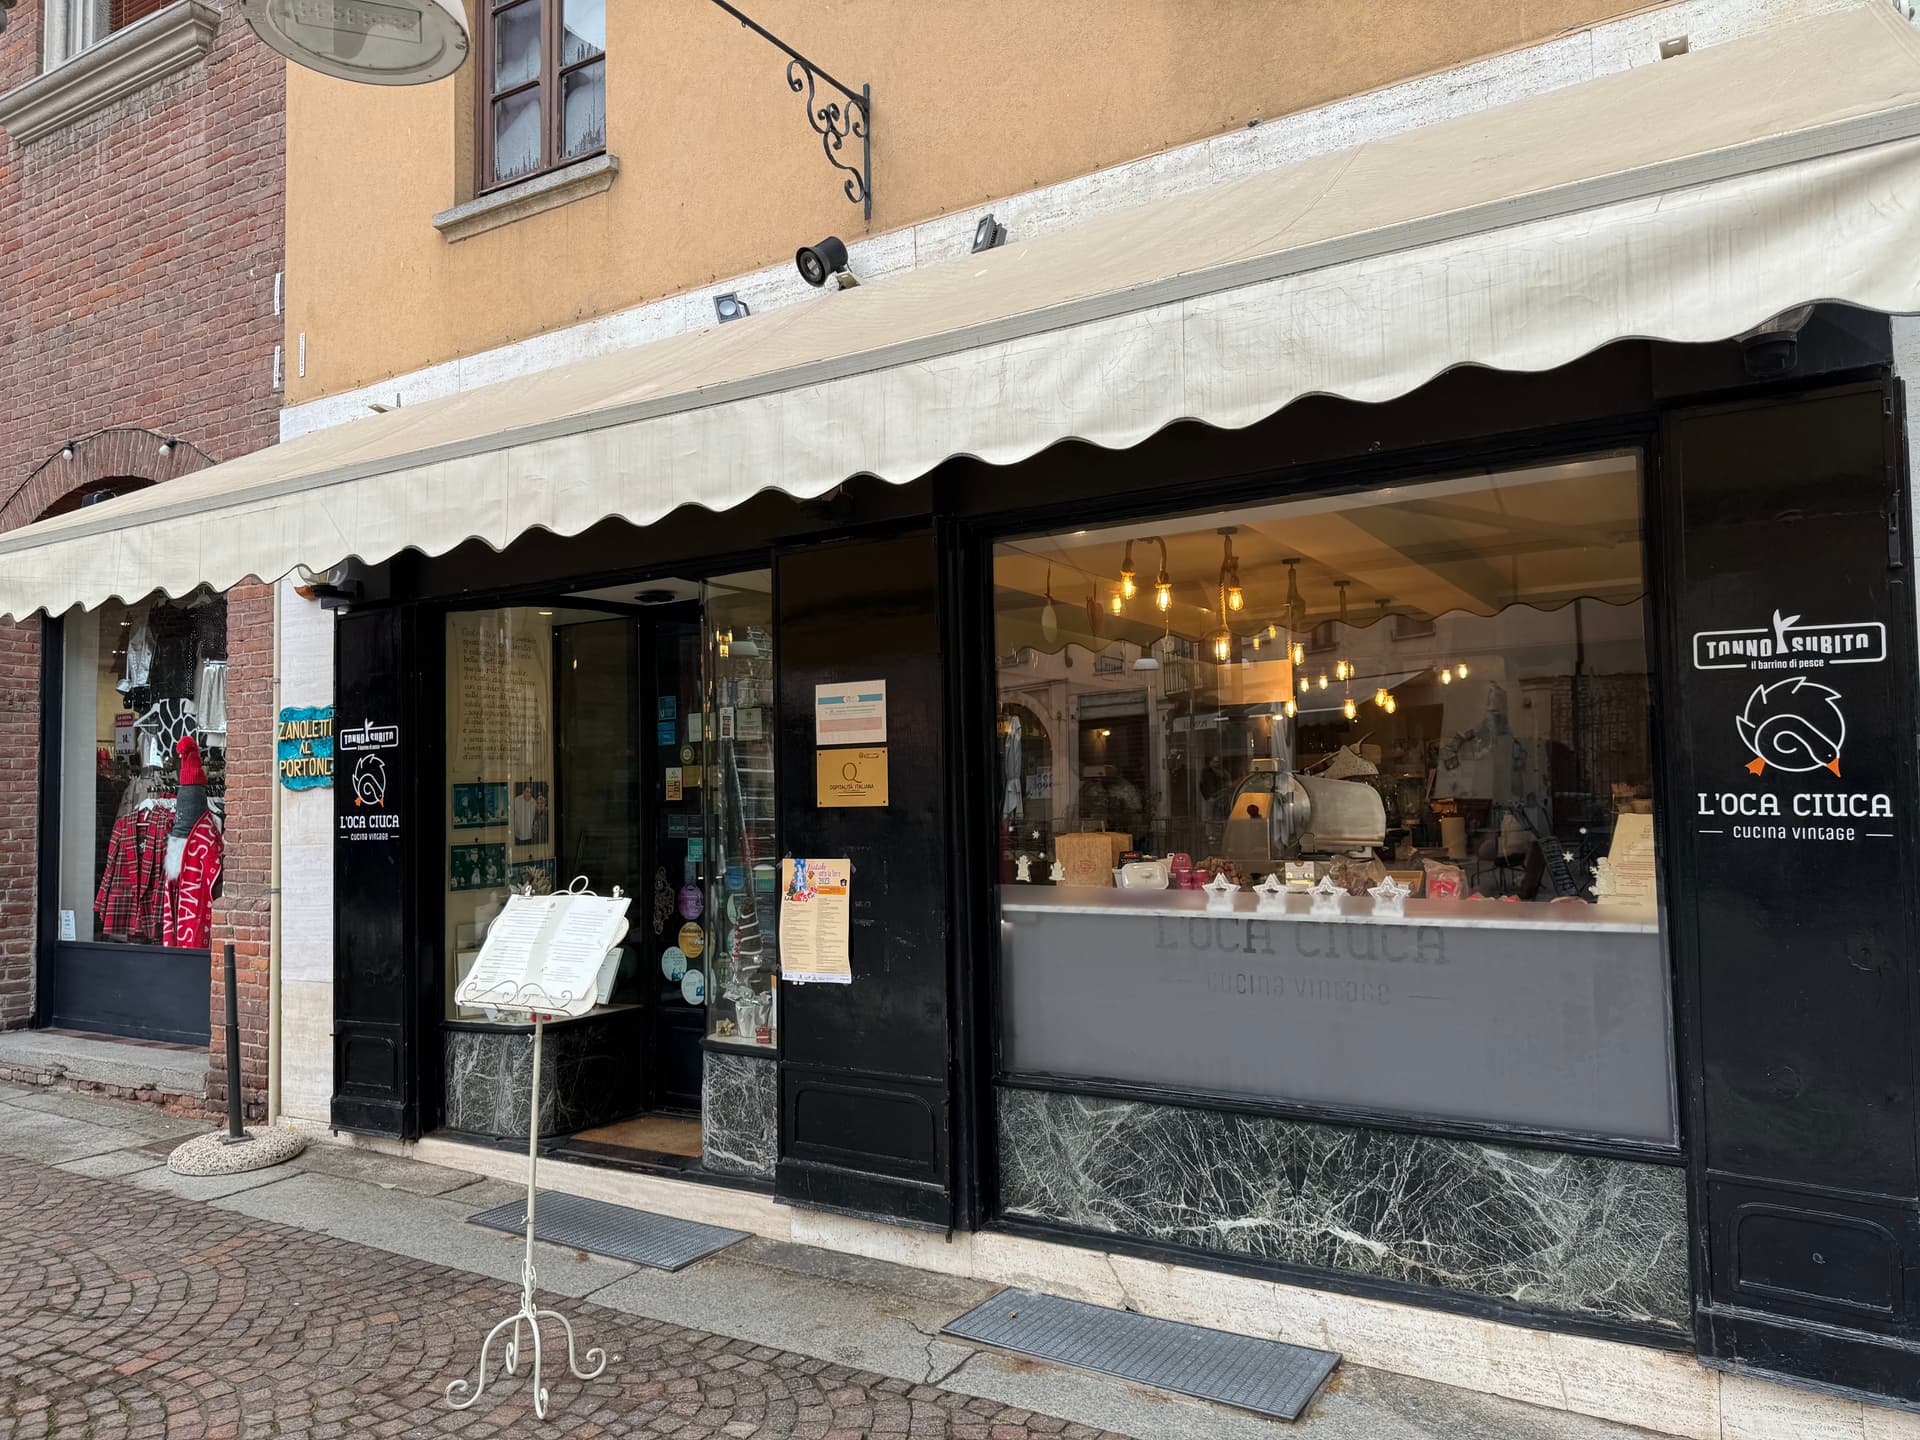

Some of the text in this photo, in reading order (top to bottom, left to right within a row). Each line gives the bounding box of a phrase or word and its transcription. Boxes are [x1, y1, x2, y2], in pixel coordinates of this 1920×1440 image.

[1751, 658, 1825, 670] il barrino di pesce
[299, 740, 312, 755] AL
[1697, 793, 1894, 818] L'OCA CIUCA
[340, 814, 400, 829] L'OCA CIUCA
[1733, 825, 1786, 839] cucina
[1154, 918, 1276, 954] LOCA
